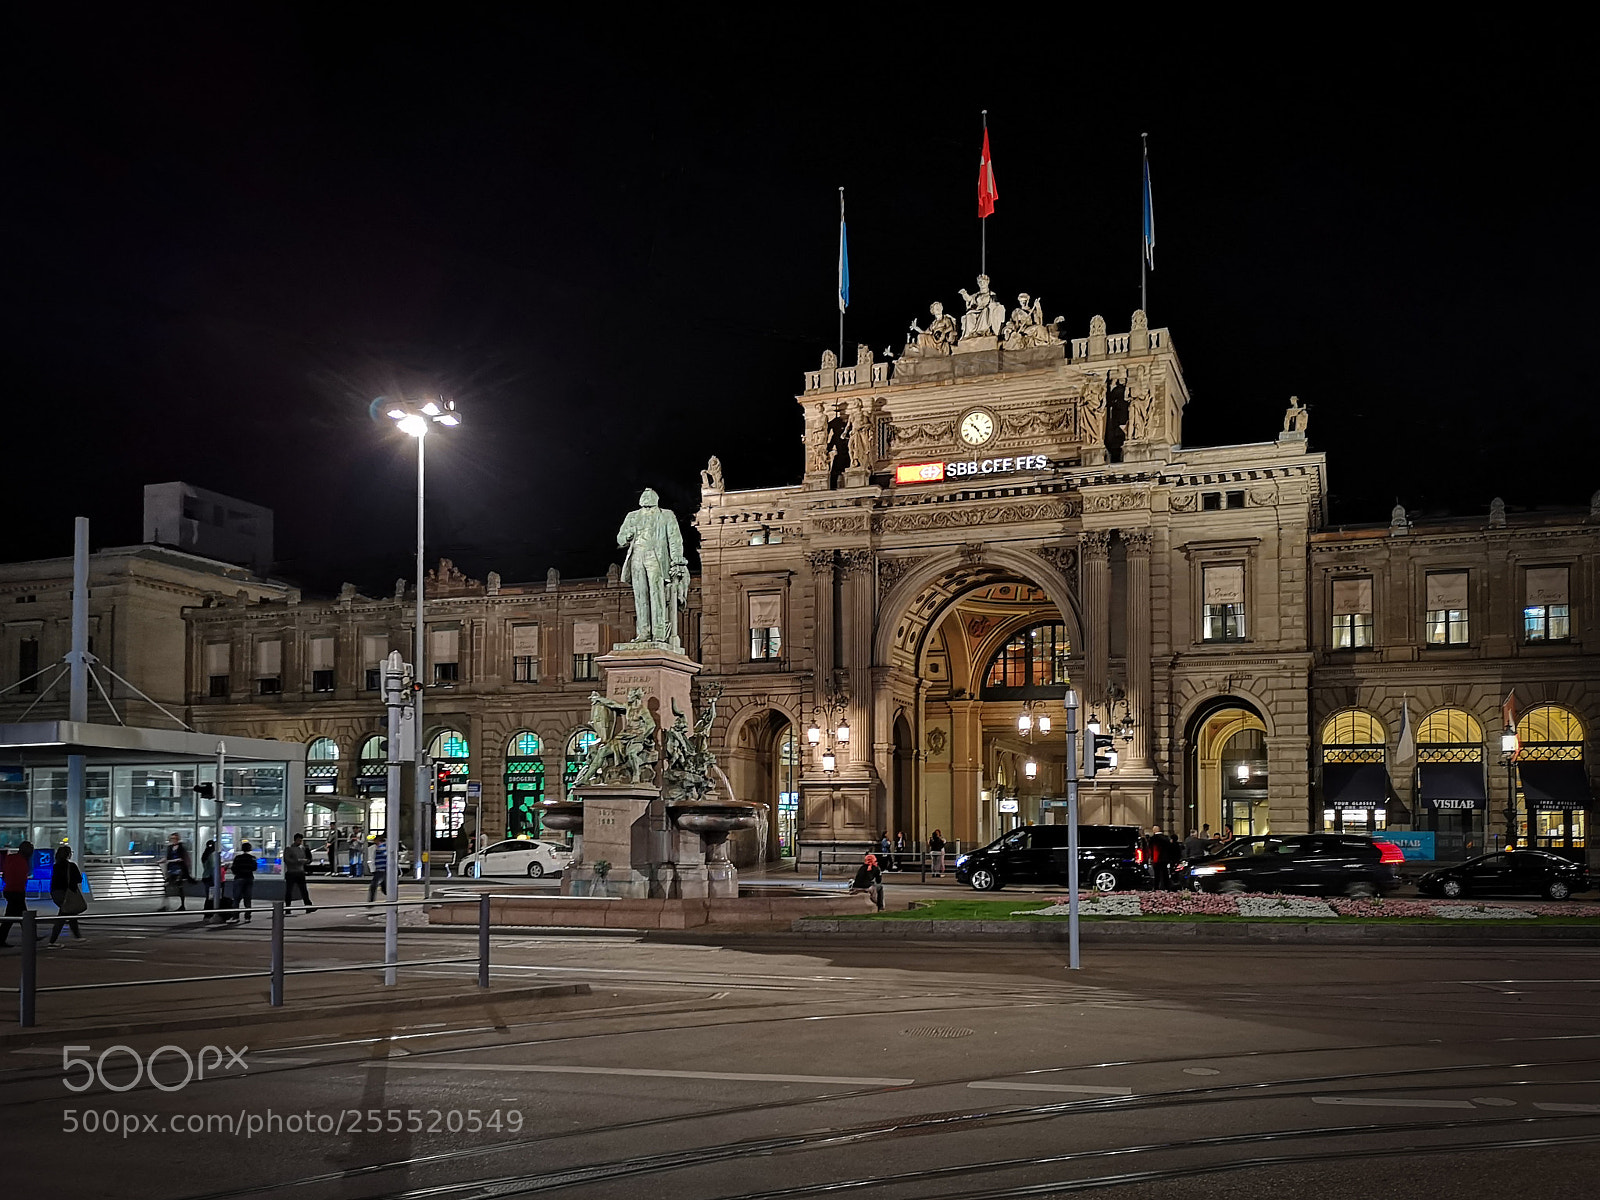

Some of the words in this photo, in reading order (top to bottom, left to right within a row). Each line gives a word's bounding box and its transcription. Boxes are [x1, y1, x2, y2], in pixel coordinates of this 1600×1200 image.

[946, 462, 978, 477] SBB
[981, 458, 1013, 473] CFF
[1016, 454, 1048, 471] FFS
[1432, 799, 1475, 809] VISILAB
